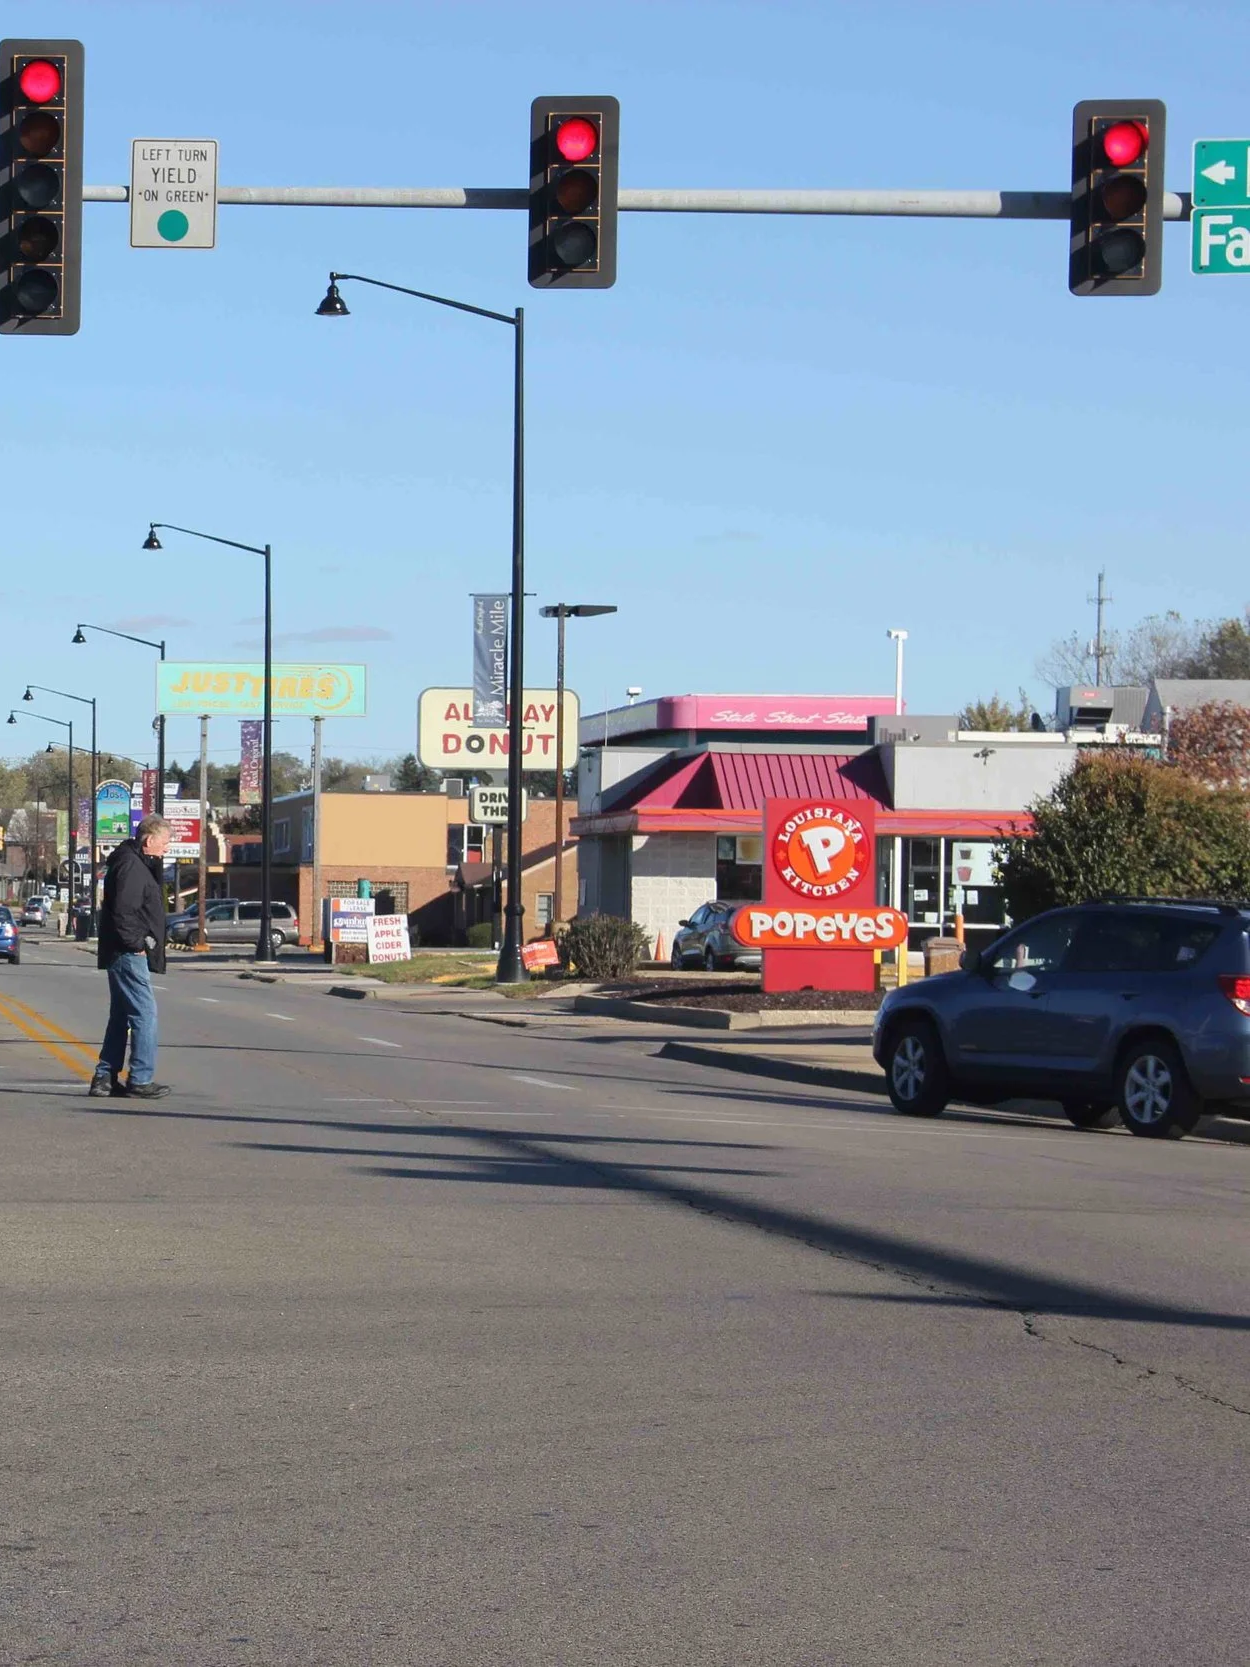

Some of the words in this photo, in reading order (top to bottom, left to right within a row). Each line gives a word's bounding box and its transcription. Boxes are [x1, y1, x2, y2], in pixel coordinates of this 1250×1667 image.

[142, 149, 171, 161] LEFT
[178, 149, 208, 162] TURN
[151, 167, 197, 184] YIELD
[143, 189, 159, 202] ON
[166, 190, 205, 203] GREEN
[1200, 215, 1250, 267] Fa
[489, 599, 505, 636] Mile
[489, 638, 505, 697] Miracle
[170, 671, 246, 694] JUST
[444, 702, 555, 723] ALAY
[709, 710, 758, 723] State
[763, 710, 823, 724] Street
[442, 733, 555, 755] DONUT
[478, 792, 509, 804] DRIV
[482, 805, 509, 817] THR
[777, 806, 863, 845] LOUISIANA
[800, 825, 846, 876] P
[780, 866, 860, 898] KITCHEN
[372, 917, 402, 926] FRESH
[374, 929, 403, 938] APPLE
[375, 941, 403, 950] CIDER
[372, 953, 409, 962] DONUTS
